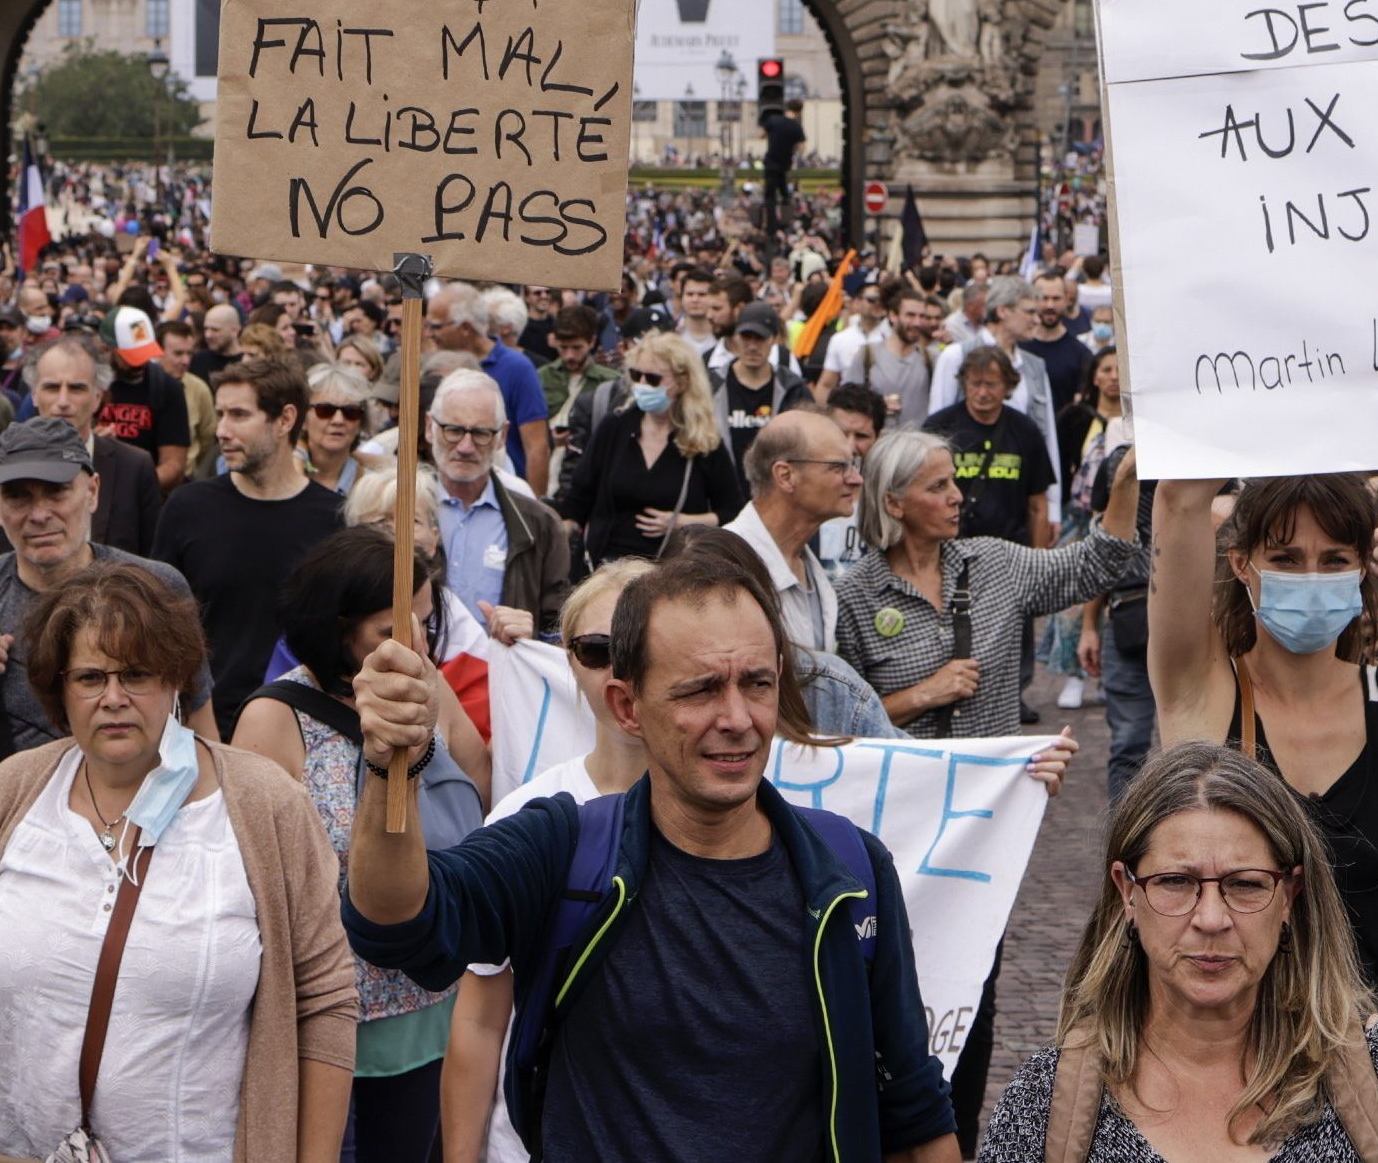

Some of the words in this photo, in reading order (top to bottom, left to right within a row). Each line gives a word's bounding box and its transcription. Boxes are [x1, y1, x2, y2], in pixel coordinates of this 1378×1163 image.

[247, 96, 319, 148] LA
[1199, 93, 1356, 162] AUX
[289, 157, 385, 239] NO
[421, 173, 608, 256] PASS
